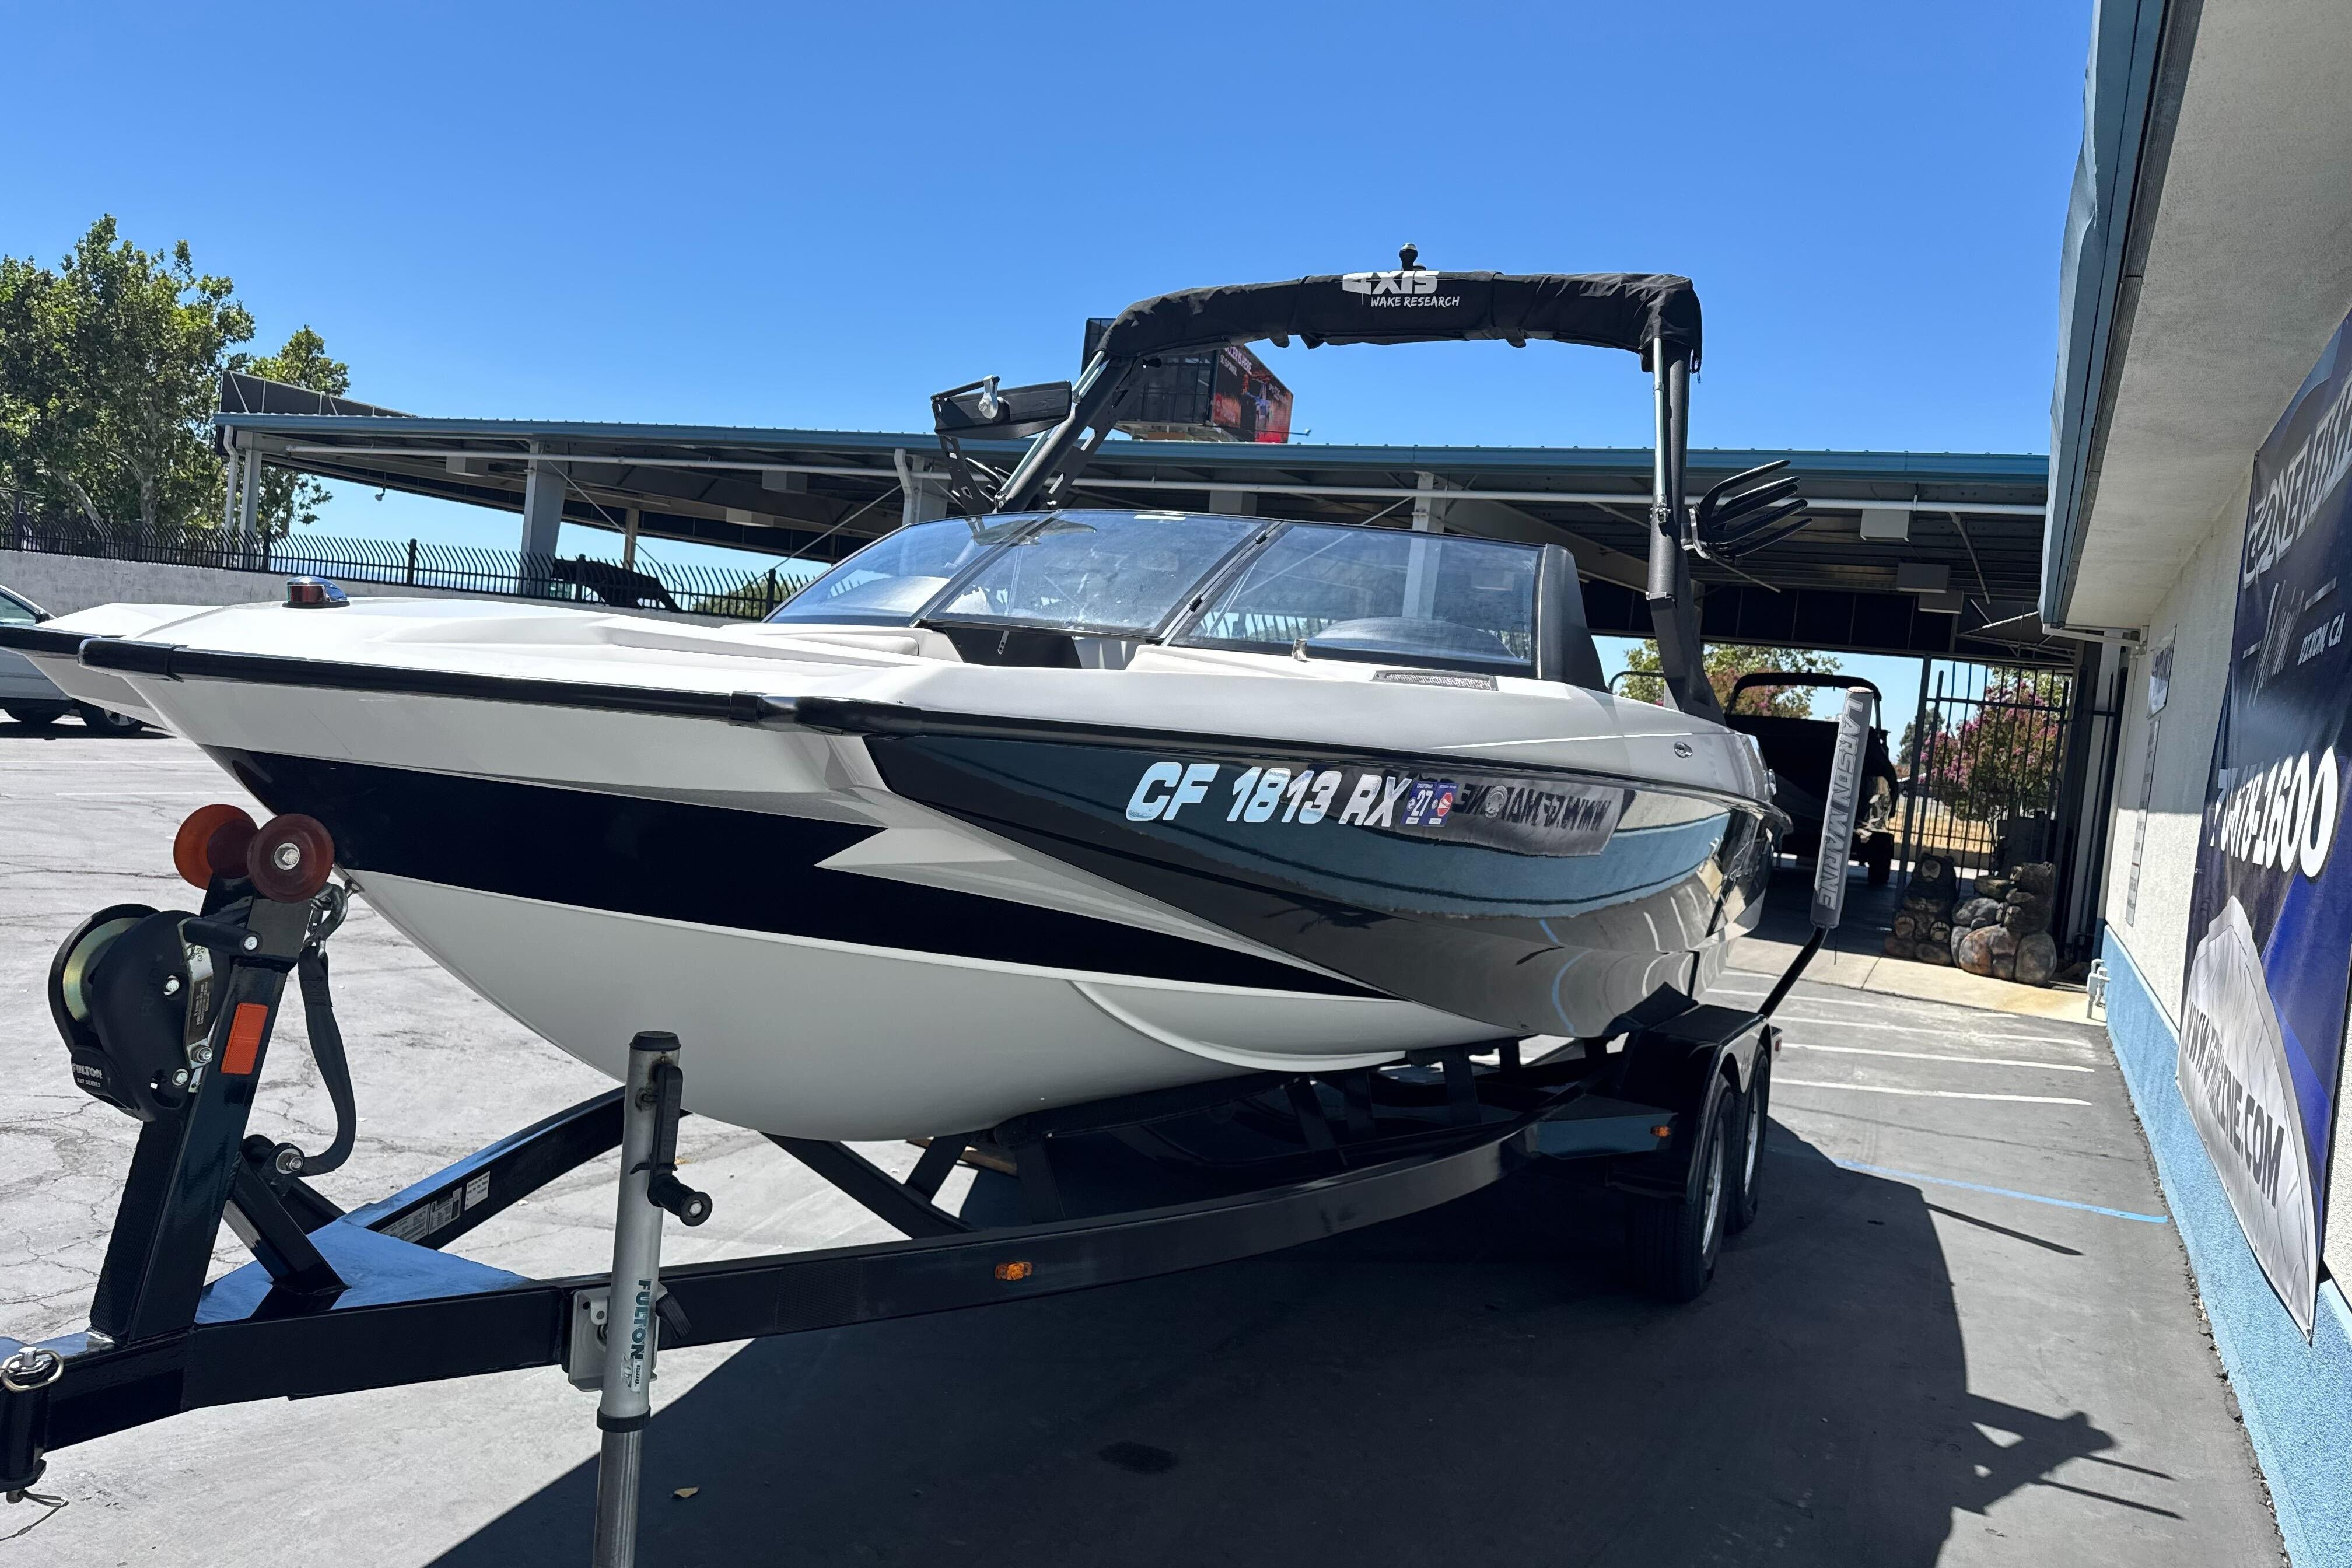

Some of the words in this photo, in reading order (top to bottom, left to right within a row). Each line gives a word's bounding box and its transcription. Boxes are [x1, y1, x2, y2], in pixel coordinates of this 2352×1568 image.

[1371, 296, 1401, 307] WAKE
[1404, 296, 1460, 308] RESEARCH
[2297, 621, 2329, 666] DIXON,
[2328, 612, 2346, 648] CA
[1833, 698, 1863, 807] LARSON
[1125, 762, 1220, 821] CF
[1226, 767, 1342, 824] 1813
[1338, 774, 1412, 827] RX
[1410, 789, 1433, 817] 27
[1817, 809, 1849, 910] MARINE
[72, 1063, 103, 1079] FULTON
[630, 1279, 653, 1360] FULTON
